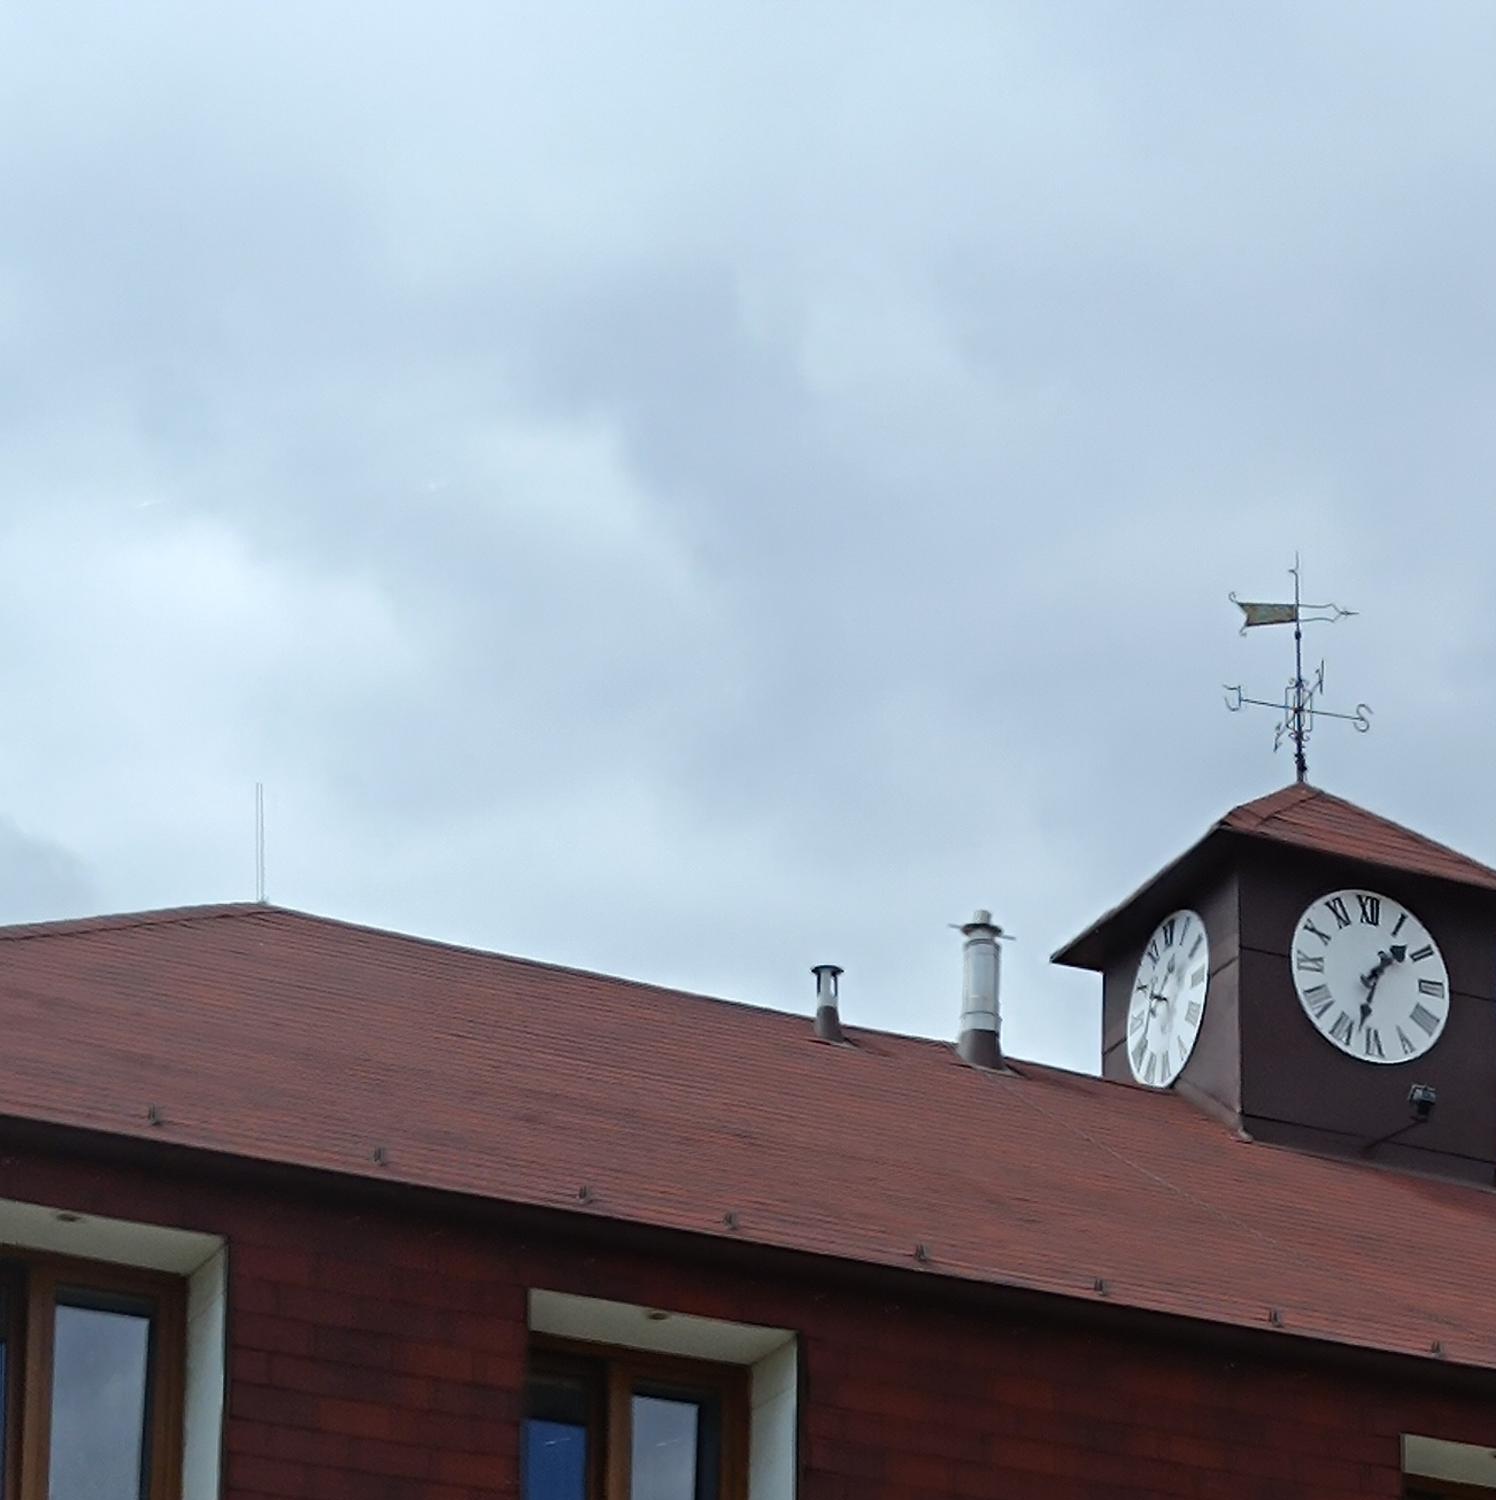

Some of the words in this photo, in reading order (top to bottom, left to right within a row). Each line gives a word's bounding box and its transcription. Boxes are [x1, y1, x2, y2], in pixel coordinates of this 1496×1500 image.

[1325, 897, 1351, 929] XI
[1357, 895, 1381, 926] XII
[1391, 913, 1409, 937] I
[1303, 918, 1331, 946] X
[1296, 949, 1325, 973] IX
[1409, 944, 1434, 963] II
[1364, 1026, 1385, 1058] VI
[1395, 1025, 1416, 1055] V
